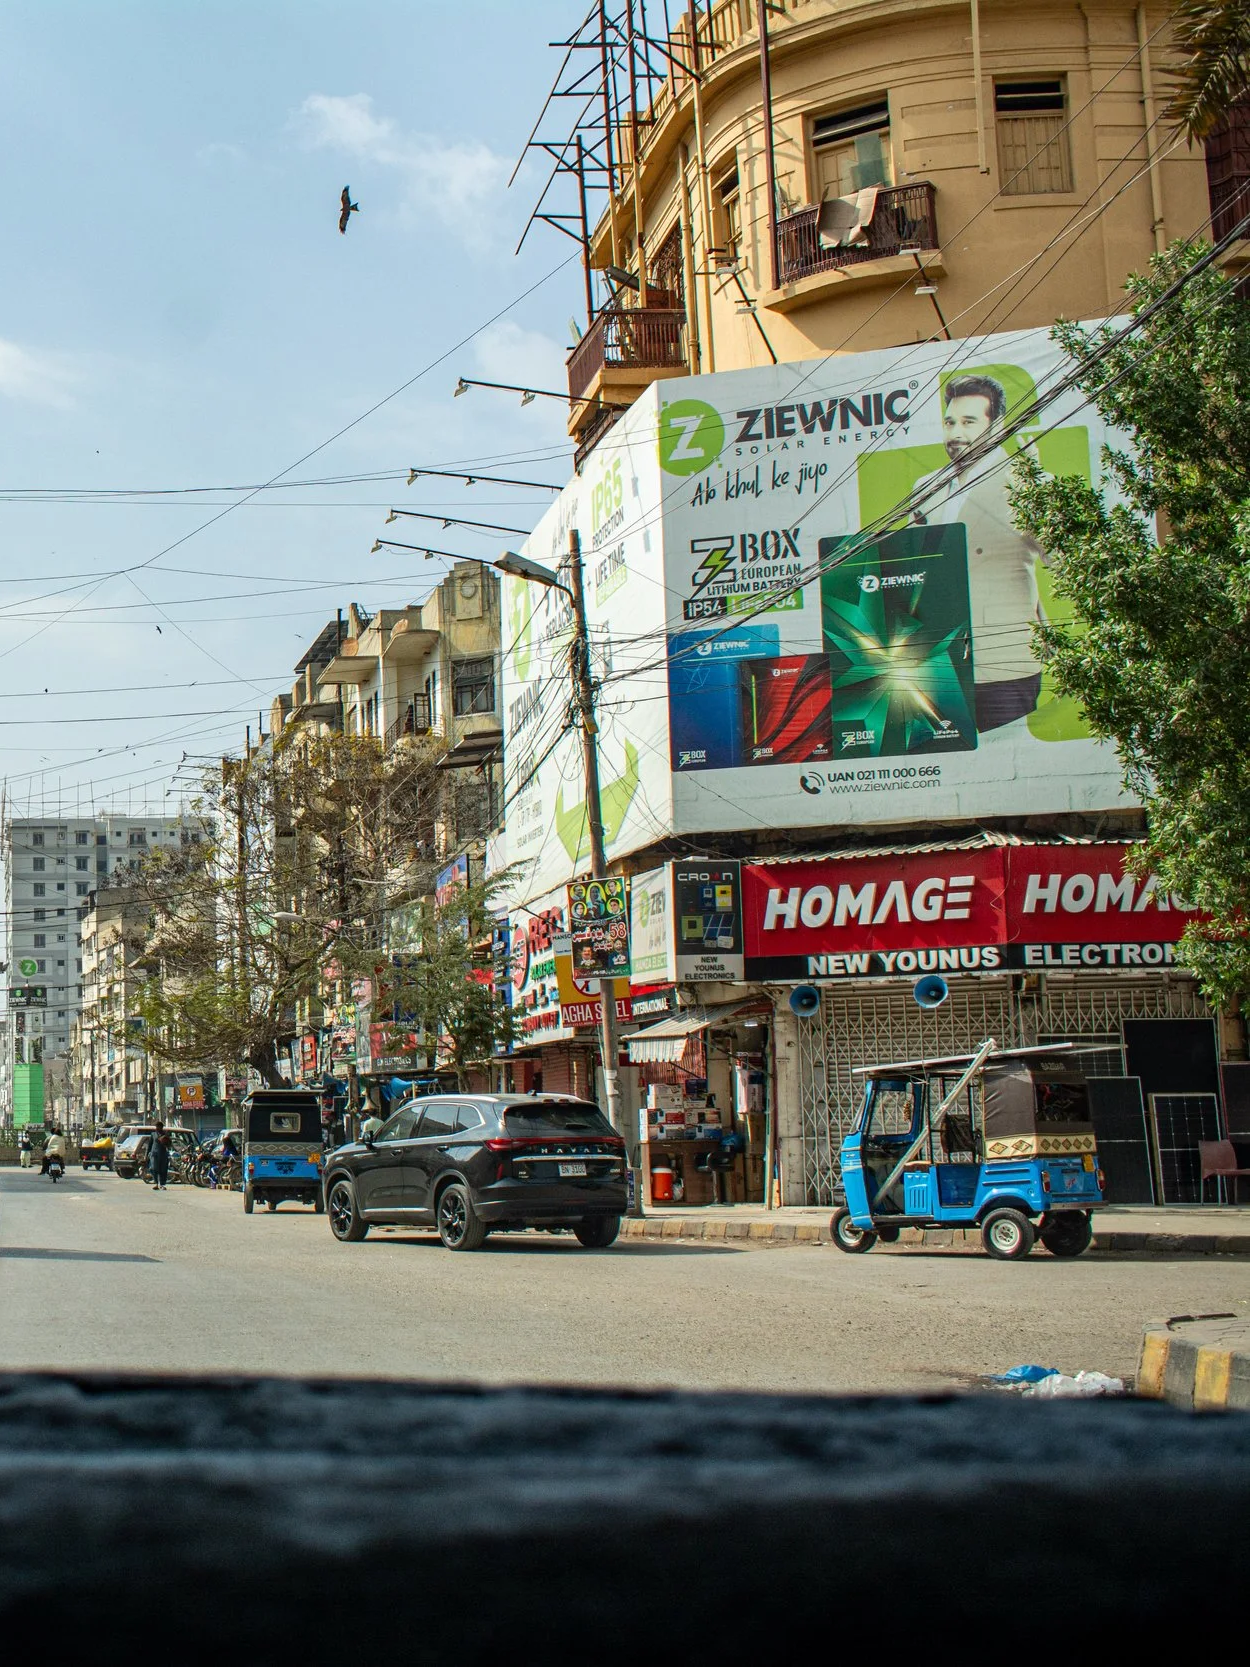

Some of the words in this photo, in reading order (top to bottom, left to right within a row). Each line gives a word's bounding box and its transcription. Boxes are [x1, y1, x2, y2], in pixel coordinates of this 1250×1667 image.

[734, 389, 911, 444] ZIEWNIC
[735, 440, 804, 457] SOLAR
[823, 426, 910, 446] ENERGY
[690, 477, 716, 507] Ab
[725, 464, 763, 501] khul
[771, 460, 790, 491] ke
[794, 461, 828, 495] jiyo
[592, 457, 623, 533] IP65
[739, 528, 801, 563] BOX
[741, 562, 801, 580] EUROPEAN
[880, 573, 925, 586] ZIEWNIC
[752, 577, 802, 592] BATTERY
[713, 640, 750, 651] ZIEWNIC
[856, 730, 875, 740] BOX
[691, 750, 706, 759] BOX
[827, 772, 855, 783] UAN
[856, 770, 875, 781] 021
[877, 769, 891, 780] 111
[892, 767, 917, 778] 000
[918, 765, 941, 777] 666
[829, 777, 941, 794] www.ziewnic.com
[763, 875, 976, 931] HOMAGE
[609, 921, 627, 939] 58
[694, 964, 725, 972] YOUNUS
[807, 953, 869, 976] NEW
[880, 946, 1001, 972] YOUNUS
[684, 972, 736, 980] ELECTRONICS
[562, 1003, 593, 1024] AGHA
[594, 1000, 631, 1021] SEL
[631, 997, 669, 1016] INTERNATIONAL
